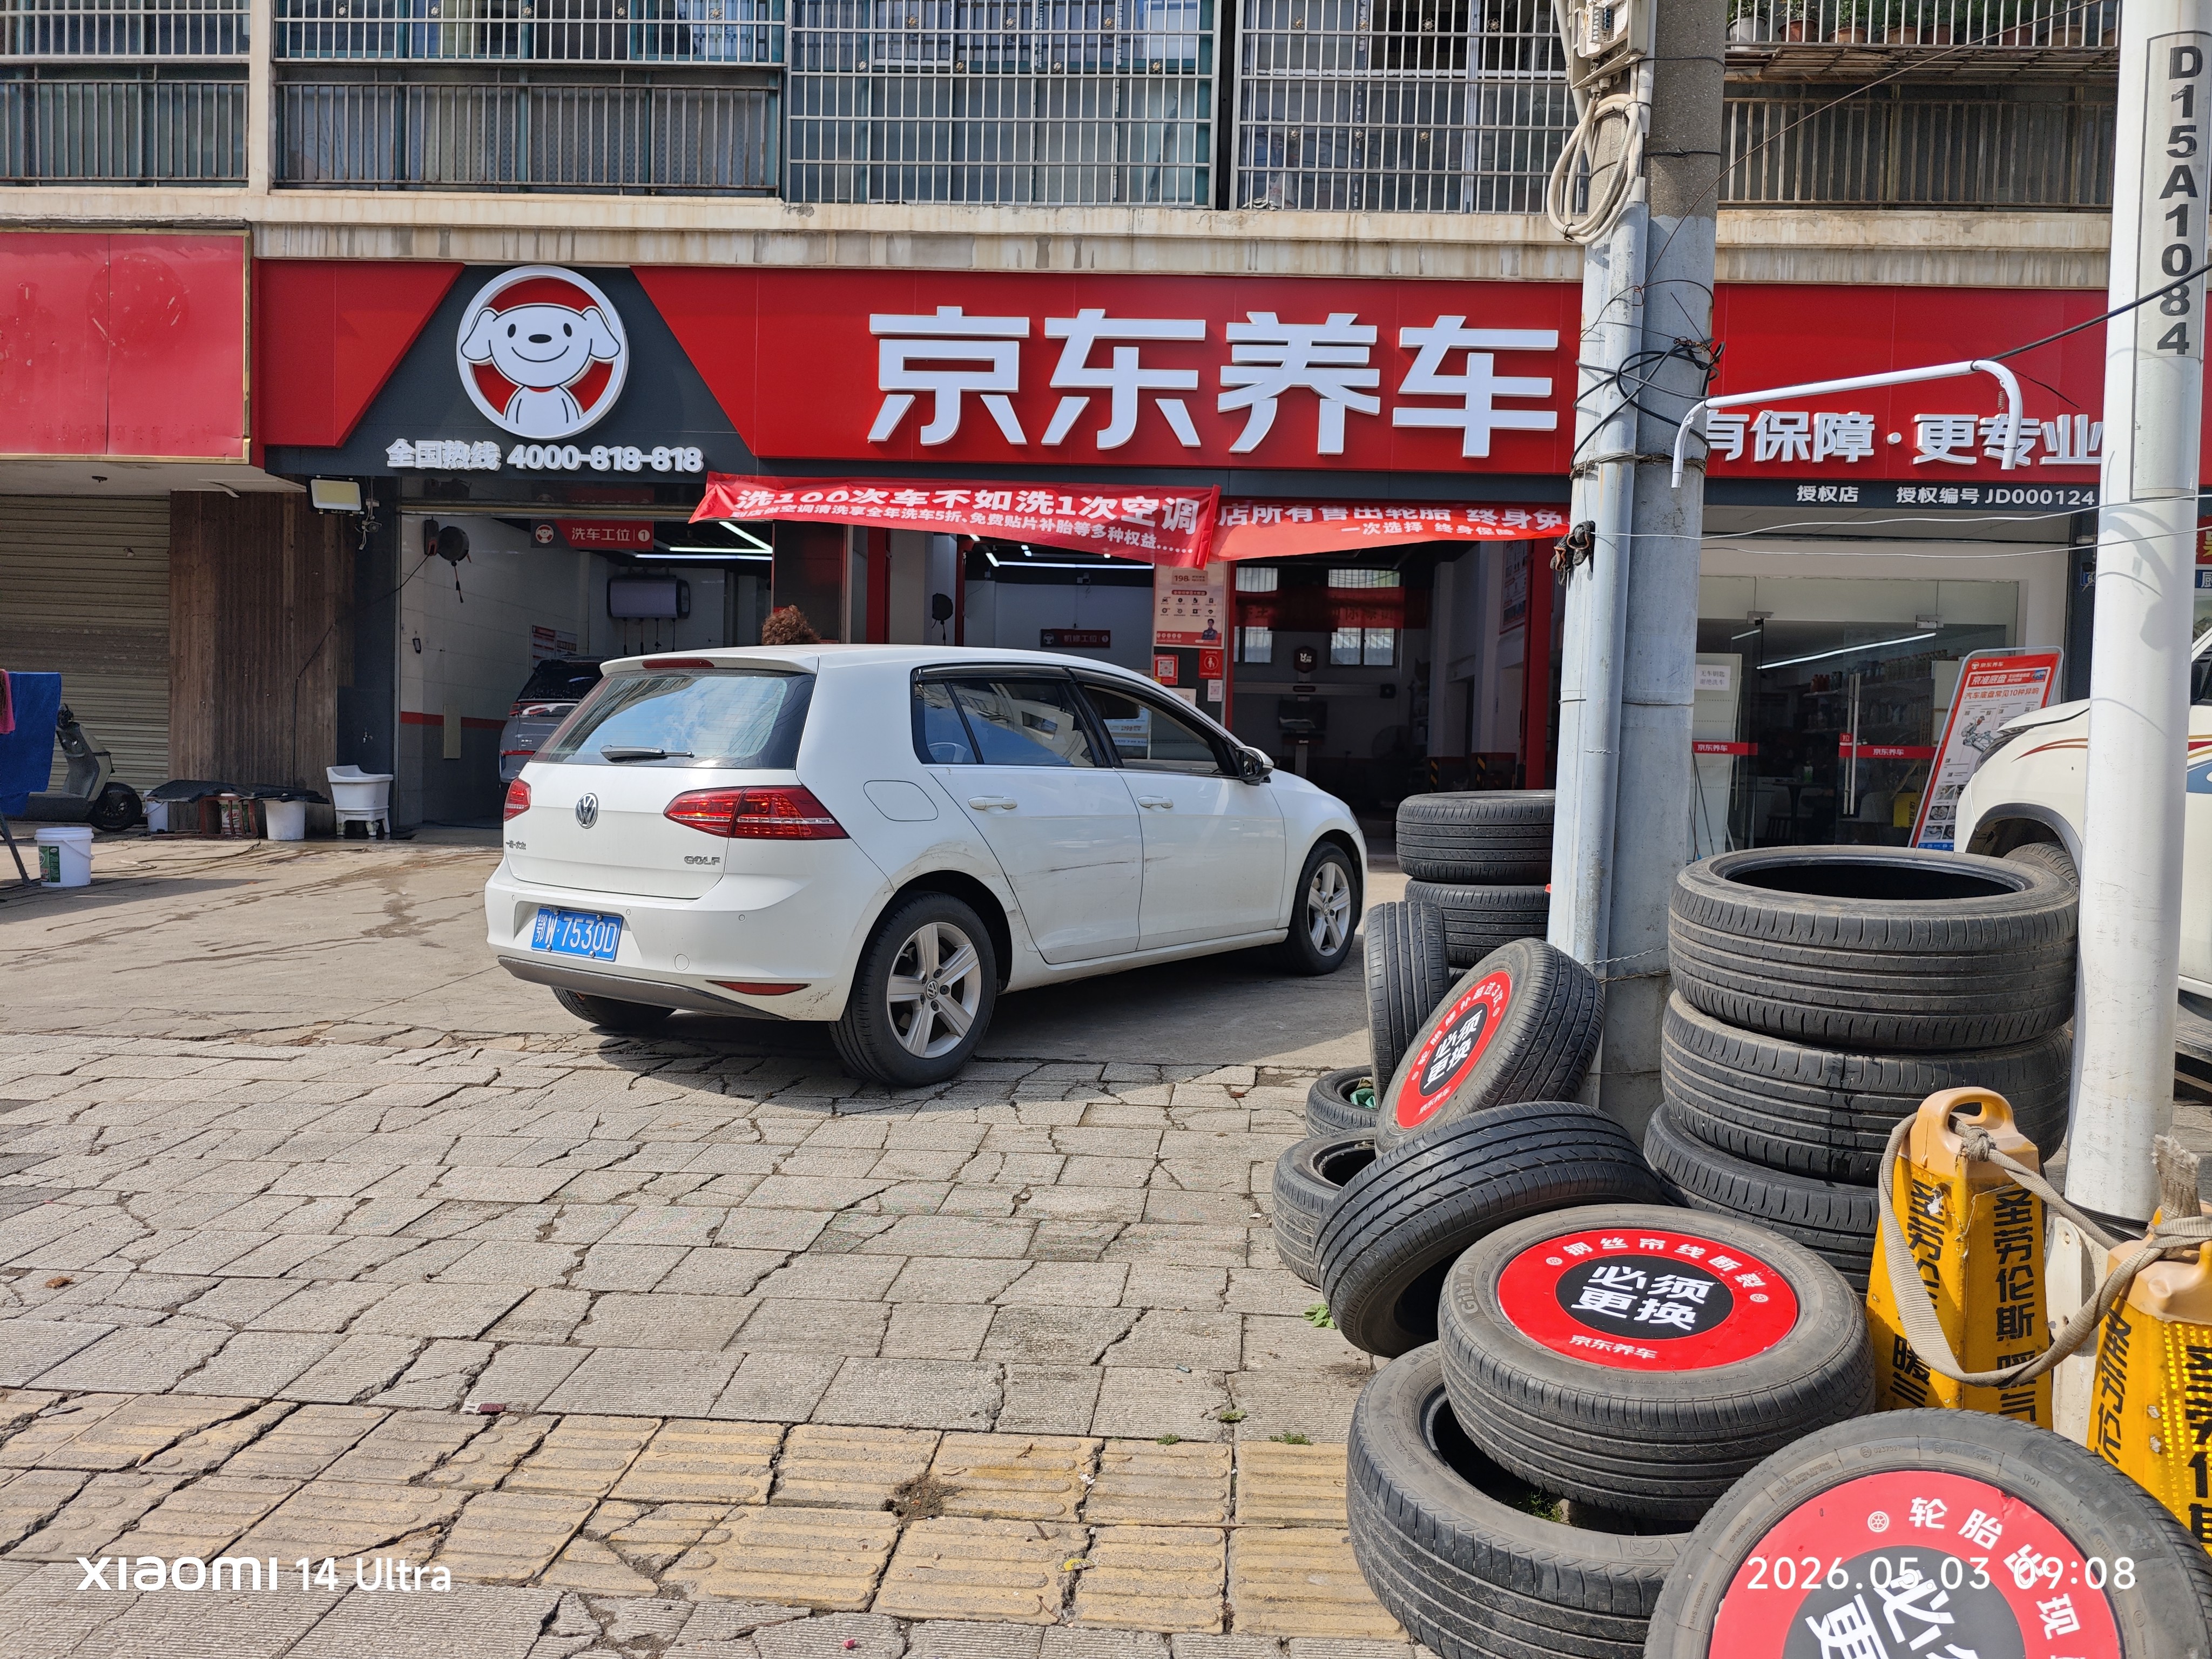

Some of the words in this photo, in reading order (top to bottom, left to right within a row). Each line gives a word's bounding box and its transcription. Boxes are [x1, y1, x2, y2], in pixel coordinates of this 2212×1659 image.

[2157, 45, 2203, 354] D15A1084
[867, 306, 1559, 458] 京东养车
[386, 439, 501, 471] 全国热线
[507, 445, 704, 473] 4000-818-818
[1797, 484, 1859, 503] 授权店
[1896, 487, 1979, 504] 授权编号
[1985, 488, 2095, 506] JD000124
[736, 488, 1200, 535] 洗100次车不如洗1次空调
[1213, 504, 1452, 527] 店所有售出轮胎
[1466, 508, 1570, 531] 终身免
[1341, 522, 1424, 535] 一次选择
[571, 527, 631, 542] 洗车工位
[1063, 635, 1097, 643] 机修工位
[1697, 744, 1728, 752] 京东养车
[1873, 748, 1905, 756] 京东养车
[684, 854, 721, 866] GOLF
[1435, 1009, 1483, 1058] 必须
[1423, 1037, 1472, 1089] 更换
[1562, 1237, 1766, 1290] 钢丝帘线断裂
[1994, 1188, 2035, 1343] 圣劳伦斯
[1587, 1265, 1715, 1304] 必须
[1570, 1285, 1696, 1331] 更换
[1568, 1334, 1658, 1360] 京东养车
[2094, 1307, 2132, 1465] 圣劳伦
[1907, 1496, 2087, 1659] 轮胎出现
[1694, 1581, 1709, 1609] TUBELESS
